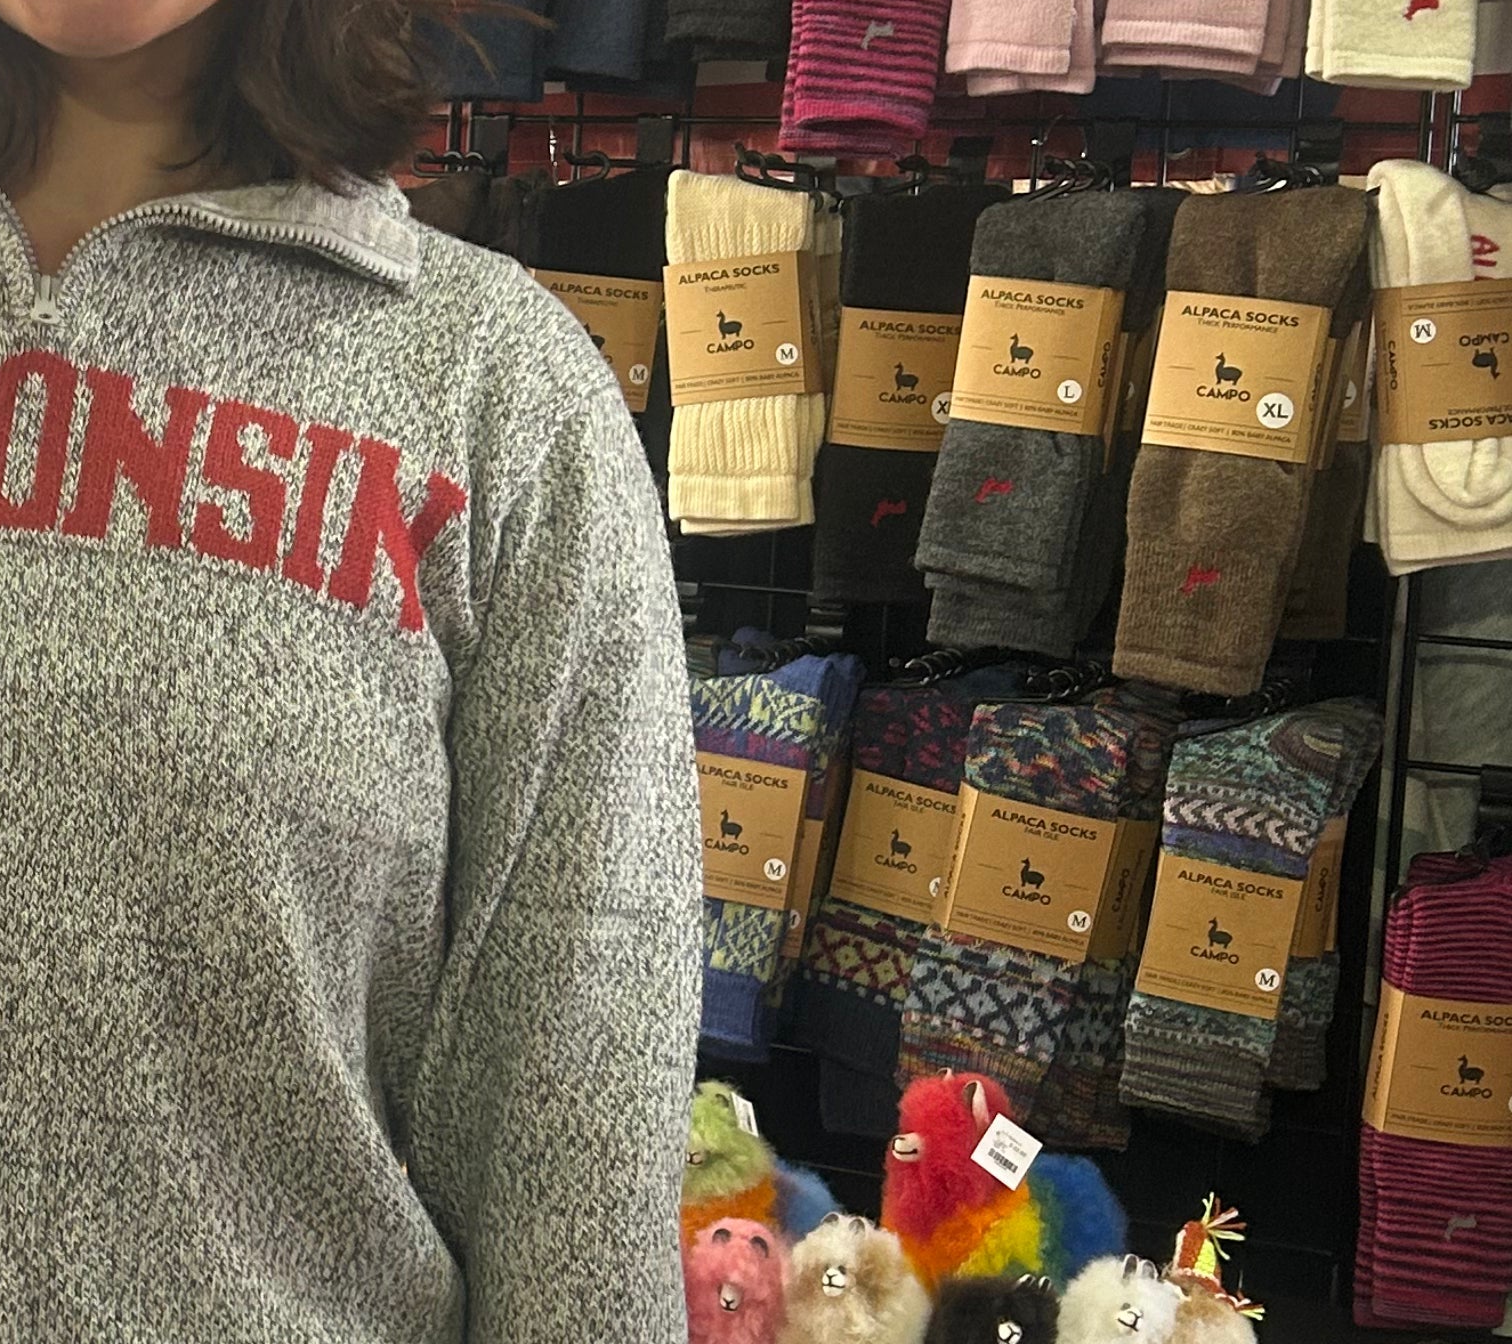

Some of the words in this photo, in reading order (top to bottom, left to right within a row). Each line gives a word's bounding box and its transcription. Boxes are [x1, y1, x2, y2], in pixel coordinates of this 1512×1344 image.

[678, 269, 729, 285] ALPACA
[733, 264, 780, 278] SOCKS
[550, 282, 602, 296] ALPACA
[605, 288, 648, 300] SOCKS
[981, 289, 1033, 304] ALPACA
[1036, 294, 1084, 309] SOCKS
[1182, 305, 1241, 320] ALPACA
[1245, 311, 1300, 327] SOCKS
[859, 320, 914, 333] ALPACA
[918, 324, 961, 335] SOCKS
[1414, 323, 1432, 339] M
[706, 339, 755, 354] CAMPO
[1459, 332, 1510, 347] CAMPO
[780, 348, 794, 359] M
[993, 364, 1041, 379] CAMPO
[1098, 341, 1111, 388] CAMPO
[1388, 340, 1398, 391] CAMPO
[633, 368, 645, 381] M
[878, 392, 927, 405] CAMPO
[1065, 385, 1074, 398] L
[1196, 386, 1251, 402] CAMPO
[1262, 403, 1289, 419] XL
[1429, 415, 1483, 430] SOCKS
[745, 773, 788, 789] SOCKS
[865, 783, 913, 803] ALPACA
[916, 796, 957, 815] SOCKS
[991, 808, 1046, 830] ALPACA
[1051, 822, 1098, 841] SOCKS
[704, 838, 750, 855] CAMPO
[767, 862, 783, 877] M
[874, 855, 918, 874] CAMPO
[1178, 870, 1233, 890] ALPACA
[1237, 882, 1284, 900] SOCKS
[1002, 886, 1052, 906] CAMPO
[1071, 915, 1086, 928] M
[1190, 946, 1239, 965] CAMPO
[1259, 973, 1276, 988] M
[1421, 1010, 1481, 1024] ALPACA
[1485, 1015, 1512, 1026] SOC
[1440, 1085, 1493, 1099] CAMPO
